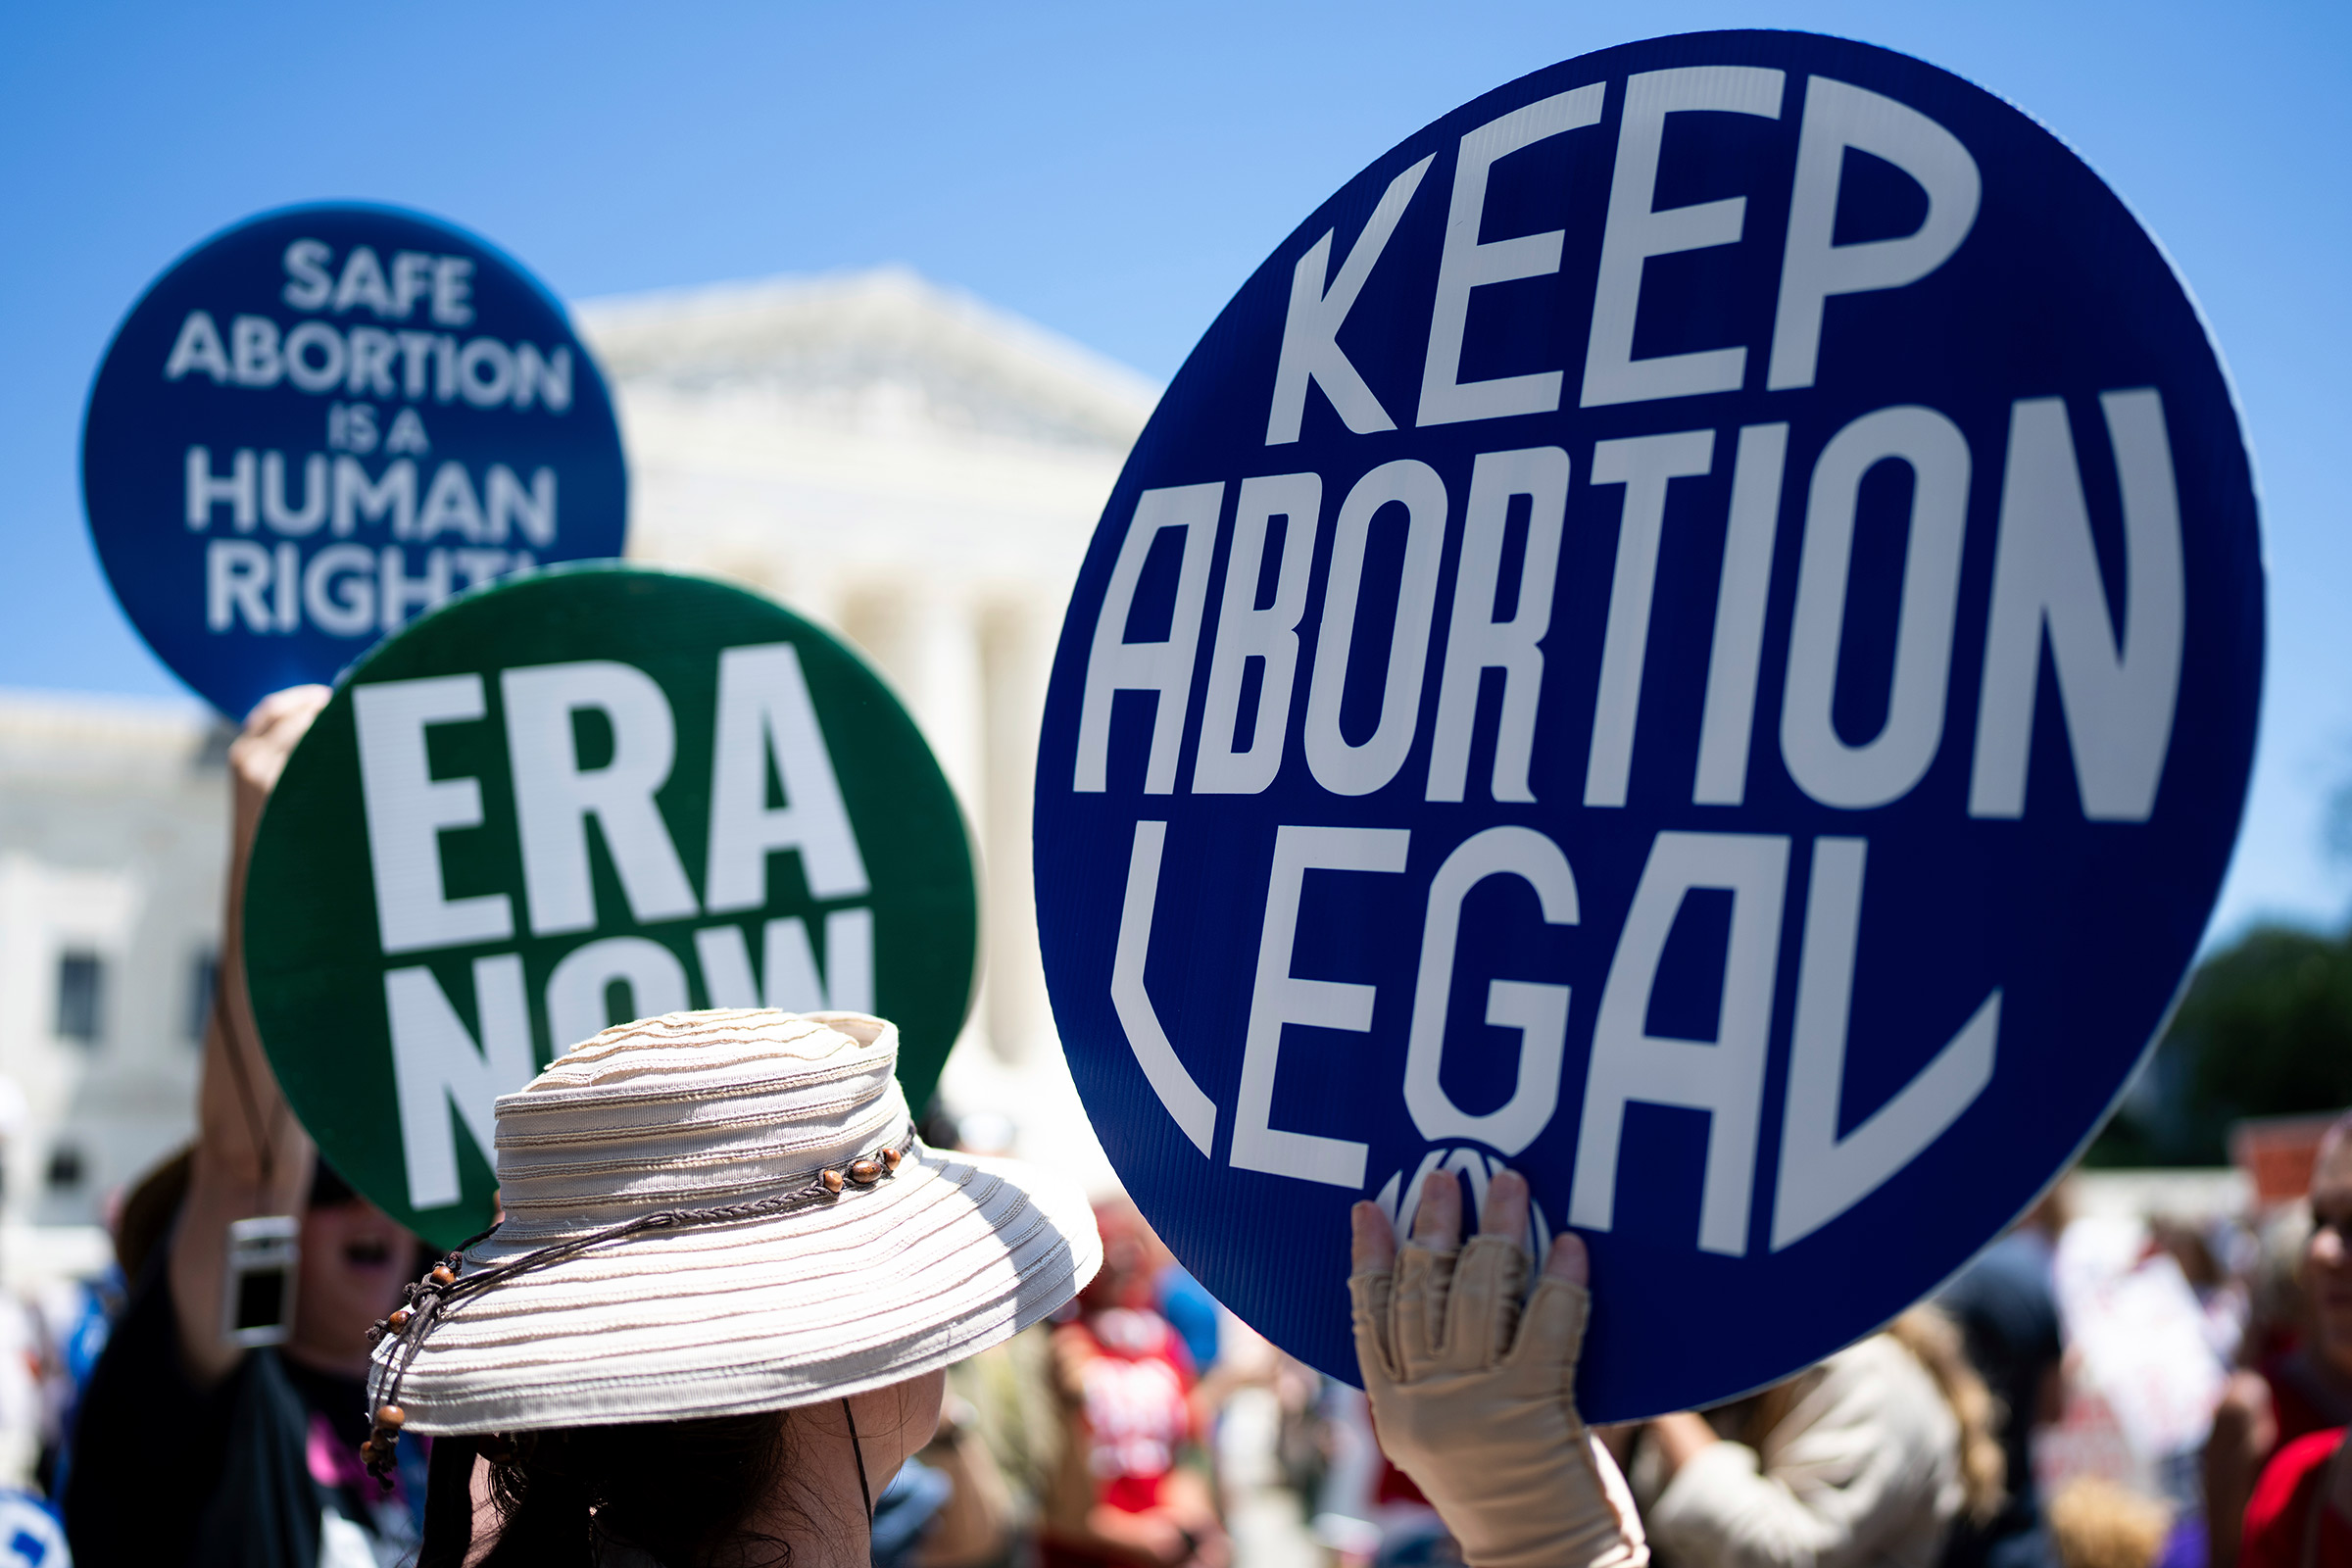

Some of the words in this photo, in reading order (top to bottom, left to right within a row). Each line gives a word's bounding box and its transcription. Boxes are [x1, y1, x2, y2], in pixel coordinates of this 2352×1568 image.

[284, 241, 473, 325] SAFE
[1264, 65, 1982, 447] KEEP
[166, 310, 573, 412] ABORTION
[327, 402, 379, 454] IS
[384, 407, 431, 455] A
[186, 447, 556, 545] HUMAN
[1073, 388, 2183, 821] ABORTION
[354, 643, 870, 954] ERA
[1110, 819, 2002, 1256] LEGAL
